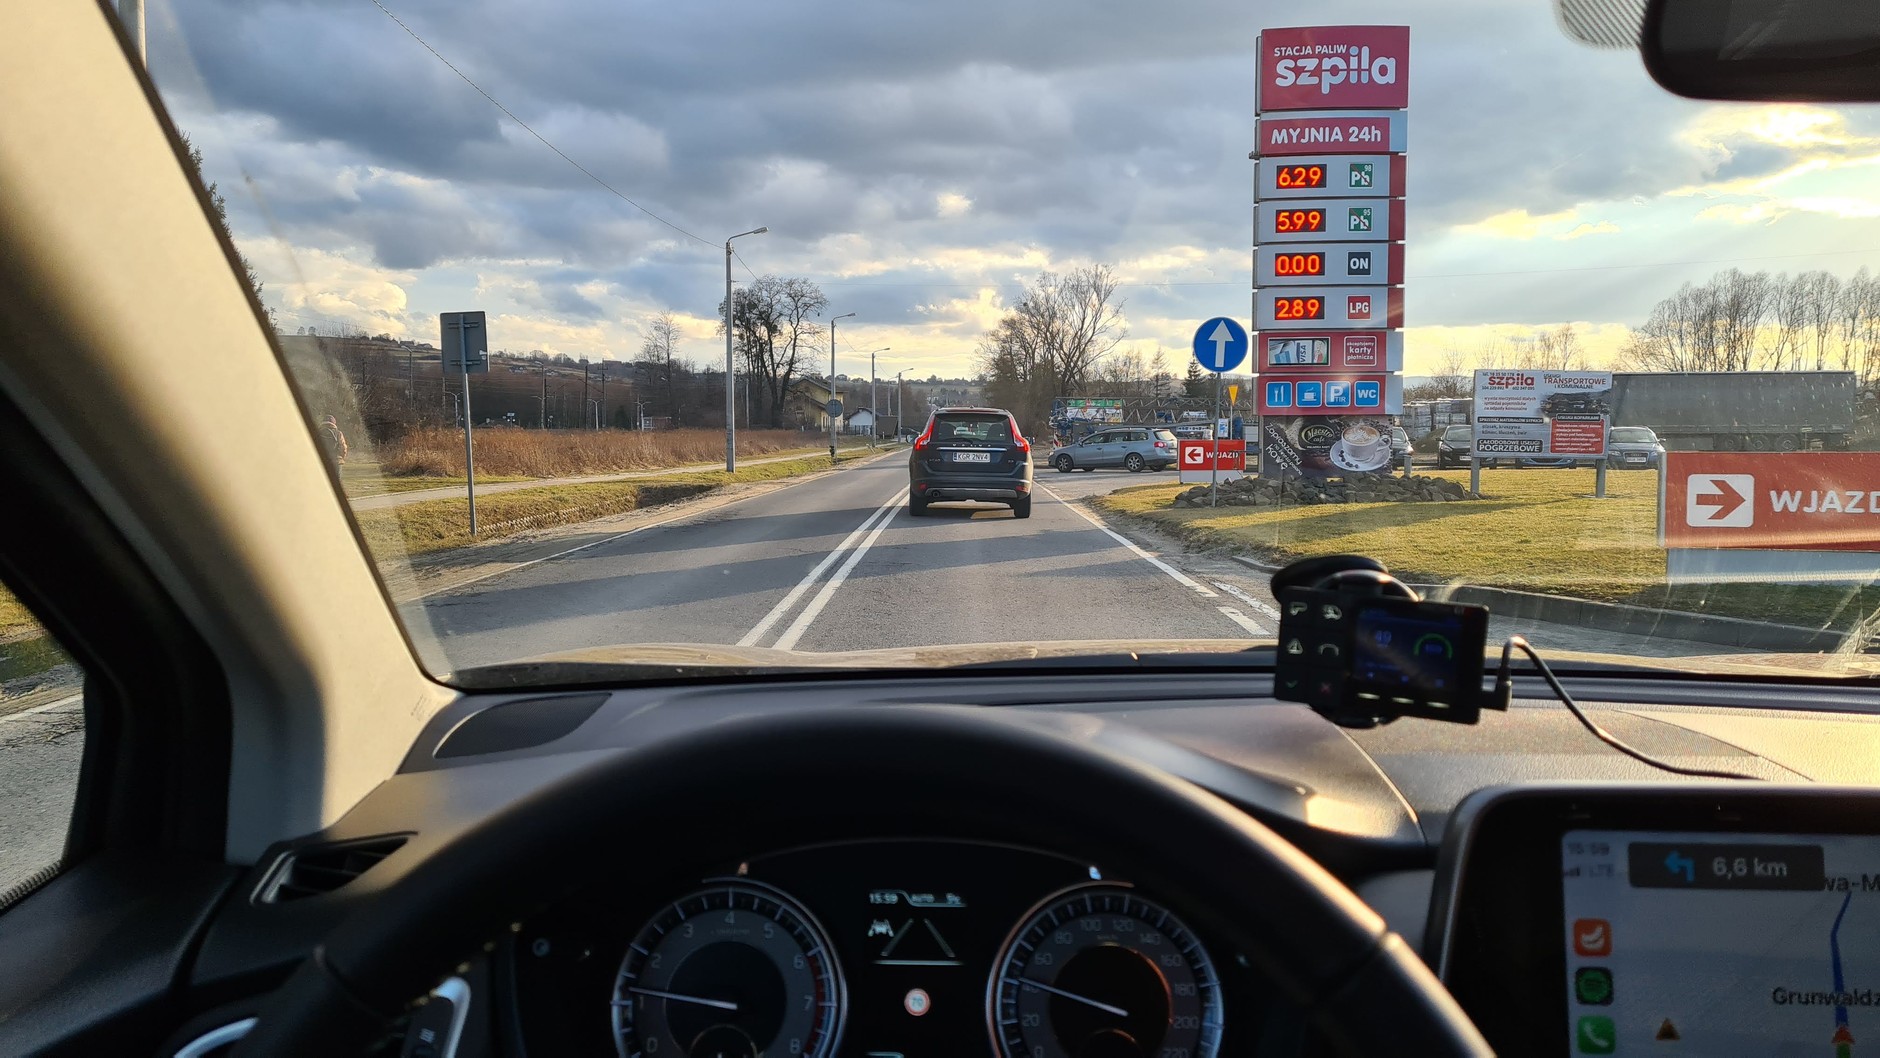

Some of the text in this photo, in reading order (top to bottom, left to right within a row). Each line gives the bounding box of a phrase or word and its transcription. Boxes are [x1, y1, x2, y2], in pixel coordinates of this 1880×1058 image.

[1274, 44, 1348, 57] STACJA PALIW
[1275, 46, 1396, 94] szpila
[1271, 126, 1381, 144] MYJNIA 24h
[1278, 166, 1322, 186] 6.29
[1278, 211, 1320, 230] 5.99
[1276, 254, 1368, 274] 0.00 ON
[1276, 298, 1369, 318] 2.89 LPG
[1488, 373, 1534, 389] szpila
[1331, 386, 1344, 402] P
[1357, 389, 1376, 398] WC
[1265, 422, 1302, 465] Zapraszamy
[1265, 443, 1288, 470] kawę
[1712, 856, 1788, 880] 6,6 km
[724, 912, 736, 924] 4
[1080, 919, 1102, 932] 100
[1113, 919, 1134, 932] 120
[683, 924, 694, 938] 3
[764, 925, 774, 939] 5
[1140, 932, 1160, 945] 140
[650, 953, 662, 968] 2
[792, 954, 804, 970] 6
[1161, 954, 1182, 967] 160
[1175, 983, 1196, 996] 180
[803, 994, 814, 1011] 7
[1022, 1014, 1039, 1026] 20
[1175, 1016, 1199, 1028] 200
[646, 1037, 658, 1053] 0
[790, 1038, 801, 1053] 8
